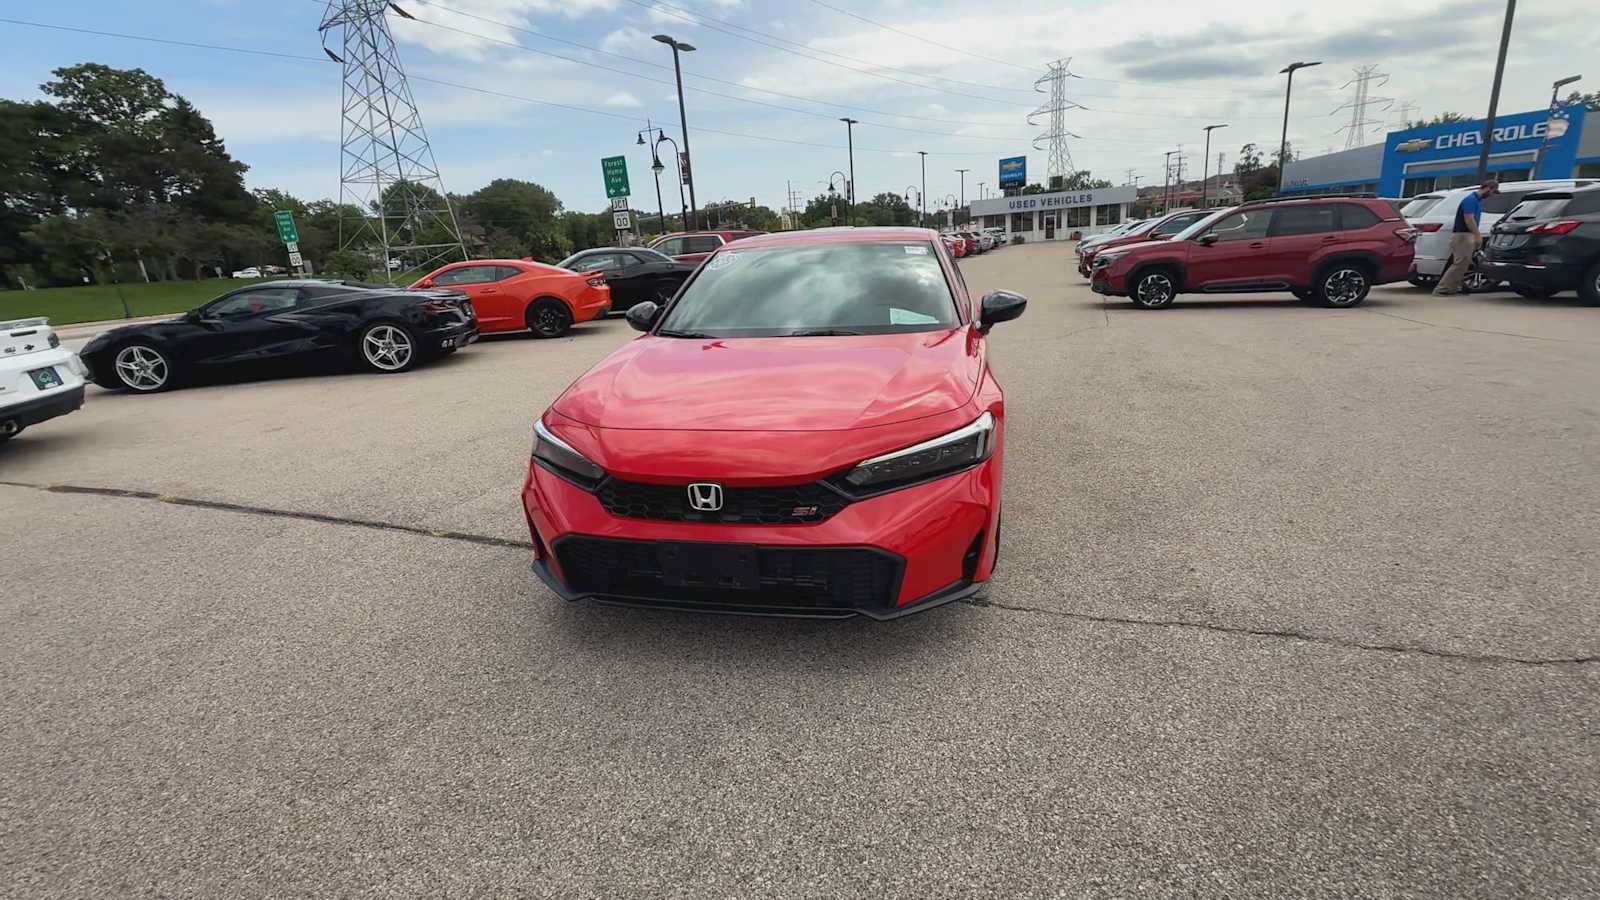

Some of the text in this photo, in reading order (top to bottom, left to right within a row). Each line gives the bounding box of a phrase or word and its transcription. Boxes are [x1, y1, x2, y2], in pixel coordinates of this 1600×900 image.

[1435, 121, 1549, 149] CHEVROLE
[604, 159, 623, 168] Forest
[607, 168, 623, 176] Home
[614, 199, 626, 209] JCT
[1008, 194, 1093, 209] USED VEHICLES
